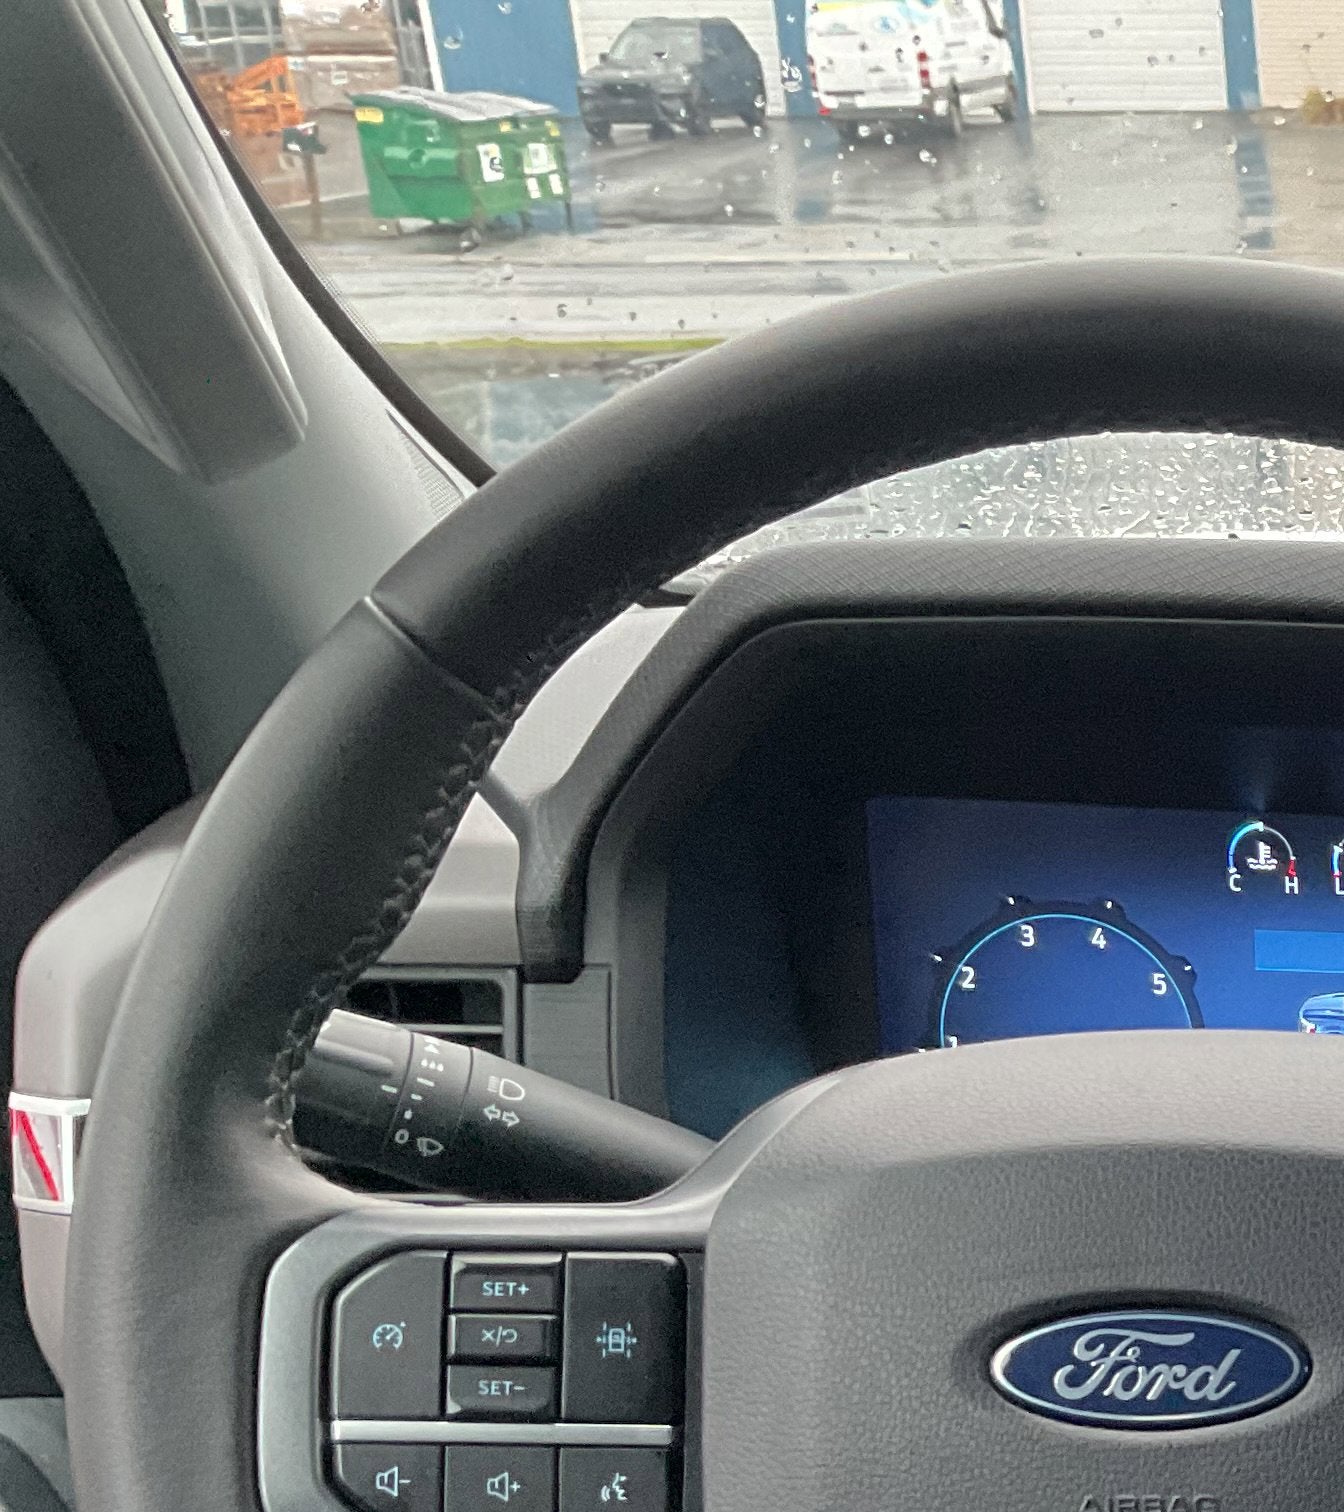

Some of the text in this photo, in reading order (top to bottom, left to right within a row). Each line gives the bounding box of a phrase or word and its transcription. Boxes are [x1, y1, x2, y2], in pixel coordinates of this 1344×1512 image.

[1229, 872, 1242, 892] C
[1284, 876, 1299, 895] H
[1020, 925, 1036, 947] 3
[1091, 927, 1107, 950] 4
[959, 966, 976, 989] 2
[1152, 972, 1167, 995] 5
[482, 1281, 530, 1297] SET+
[1053, 1327, 1244, 1401] Ford
